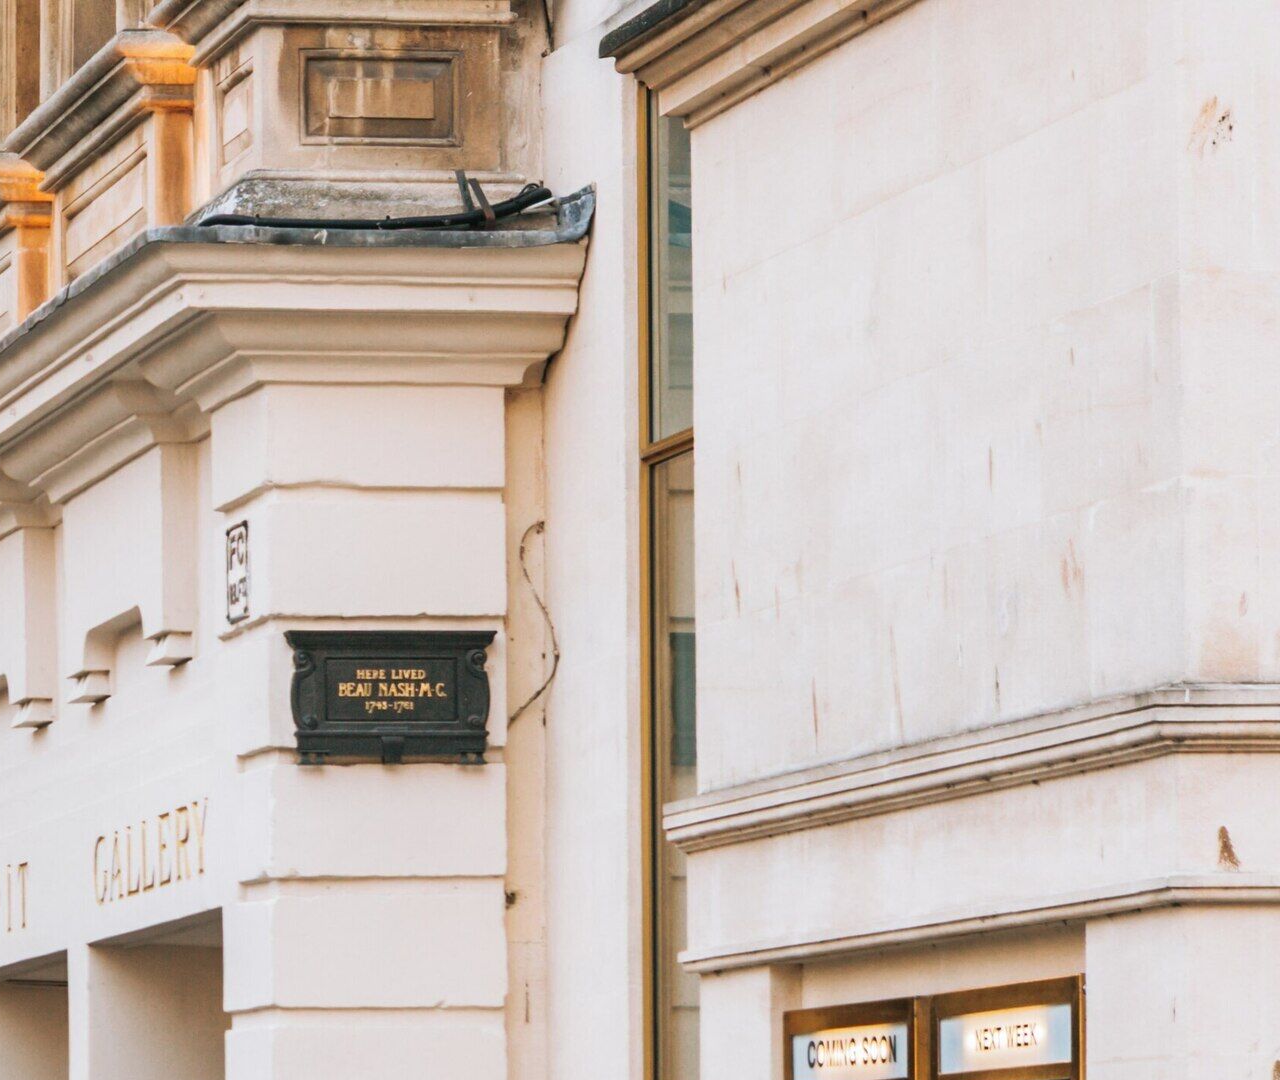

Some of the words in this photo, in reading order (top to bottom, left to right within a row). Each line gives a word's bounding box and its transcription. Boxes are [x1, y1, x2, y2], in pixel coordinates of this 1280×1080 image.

[356, 669, 386, 680] HERE
[391, 669, 426, 680] LIVED
[338, 683, 372, 697] BEAU
[94, 797, 209, 906] GALLERY
[807, 1038, 857, 1069] COMING
[862, 1033, 898, 1065] SOON
[975, 1026, 1001, 1051] NEXT
[1004, 1023, 1038, 1048] WEEK
